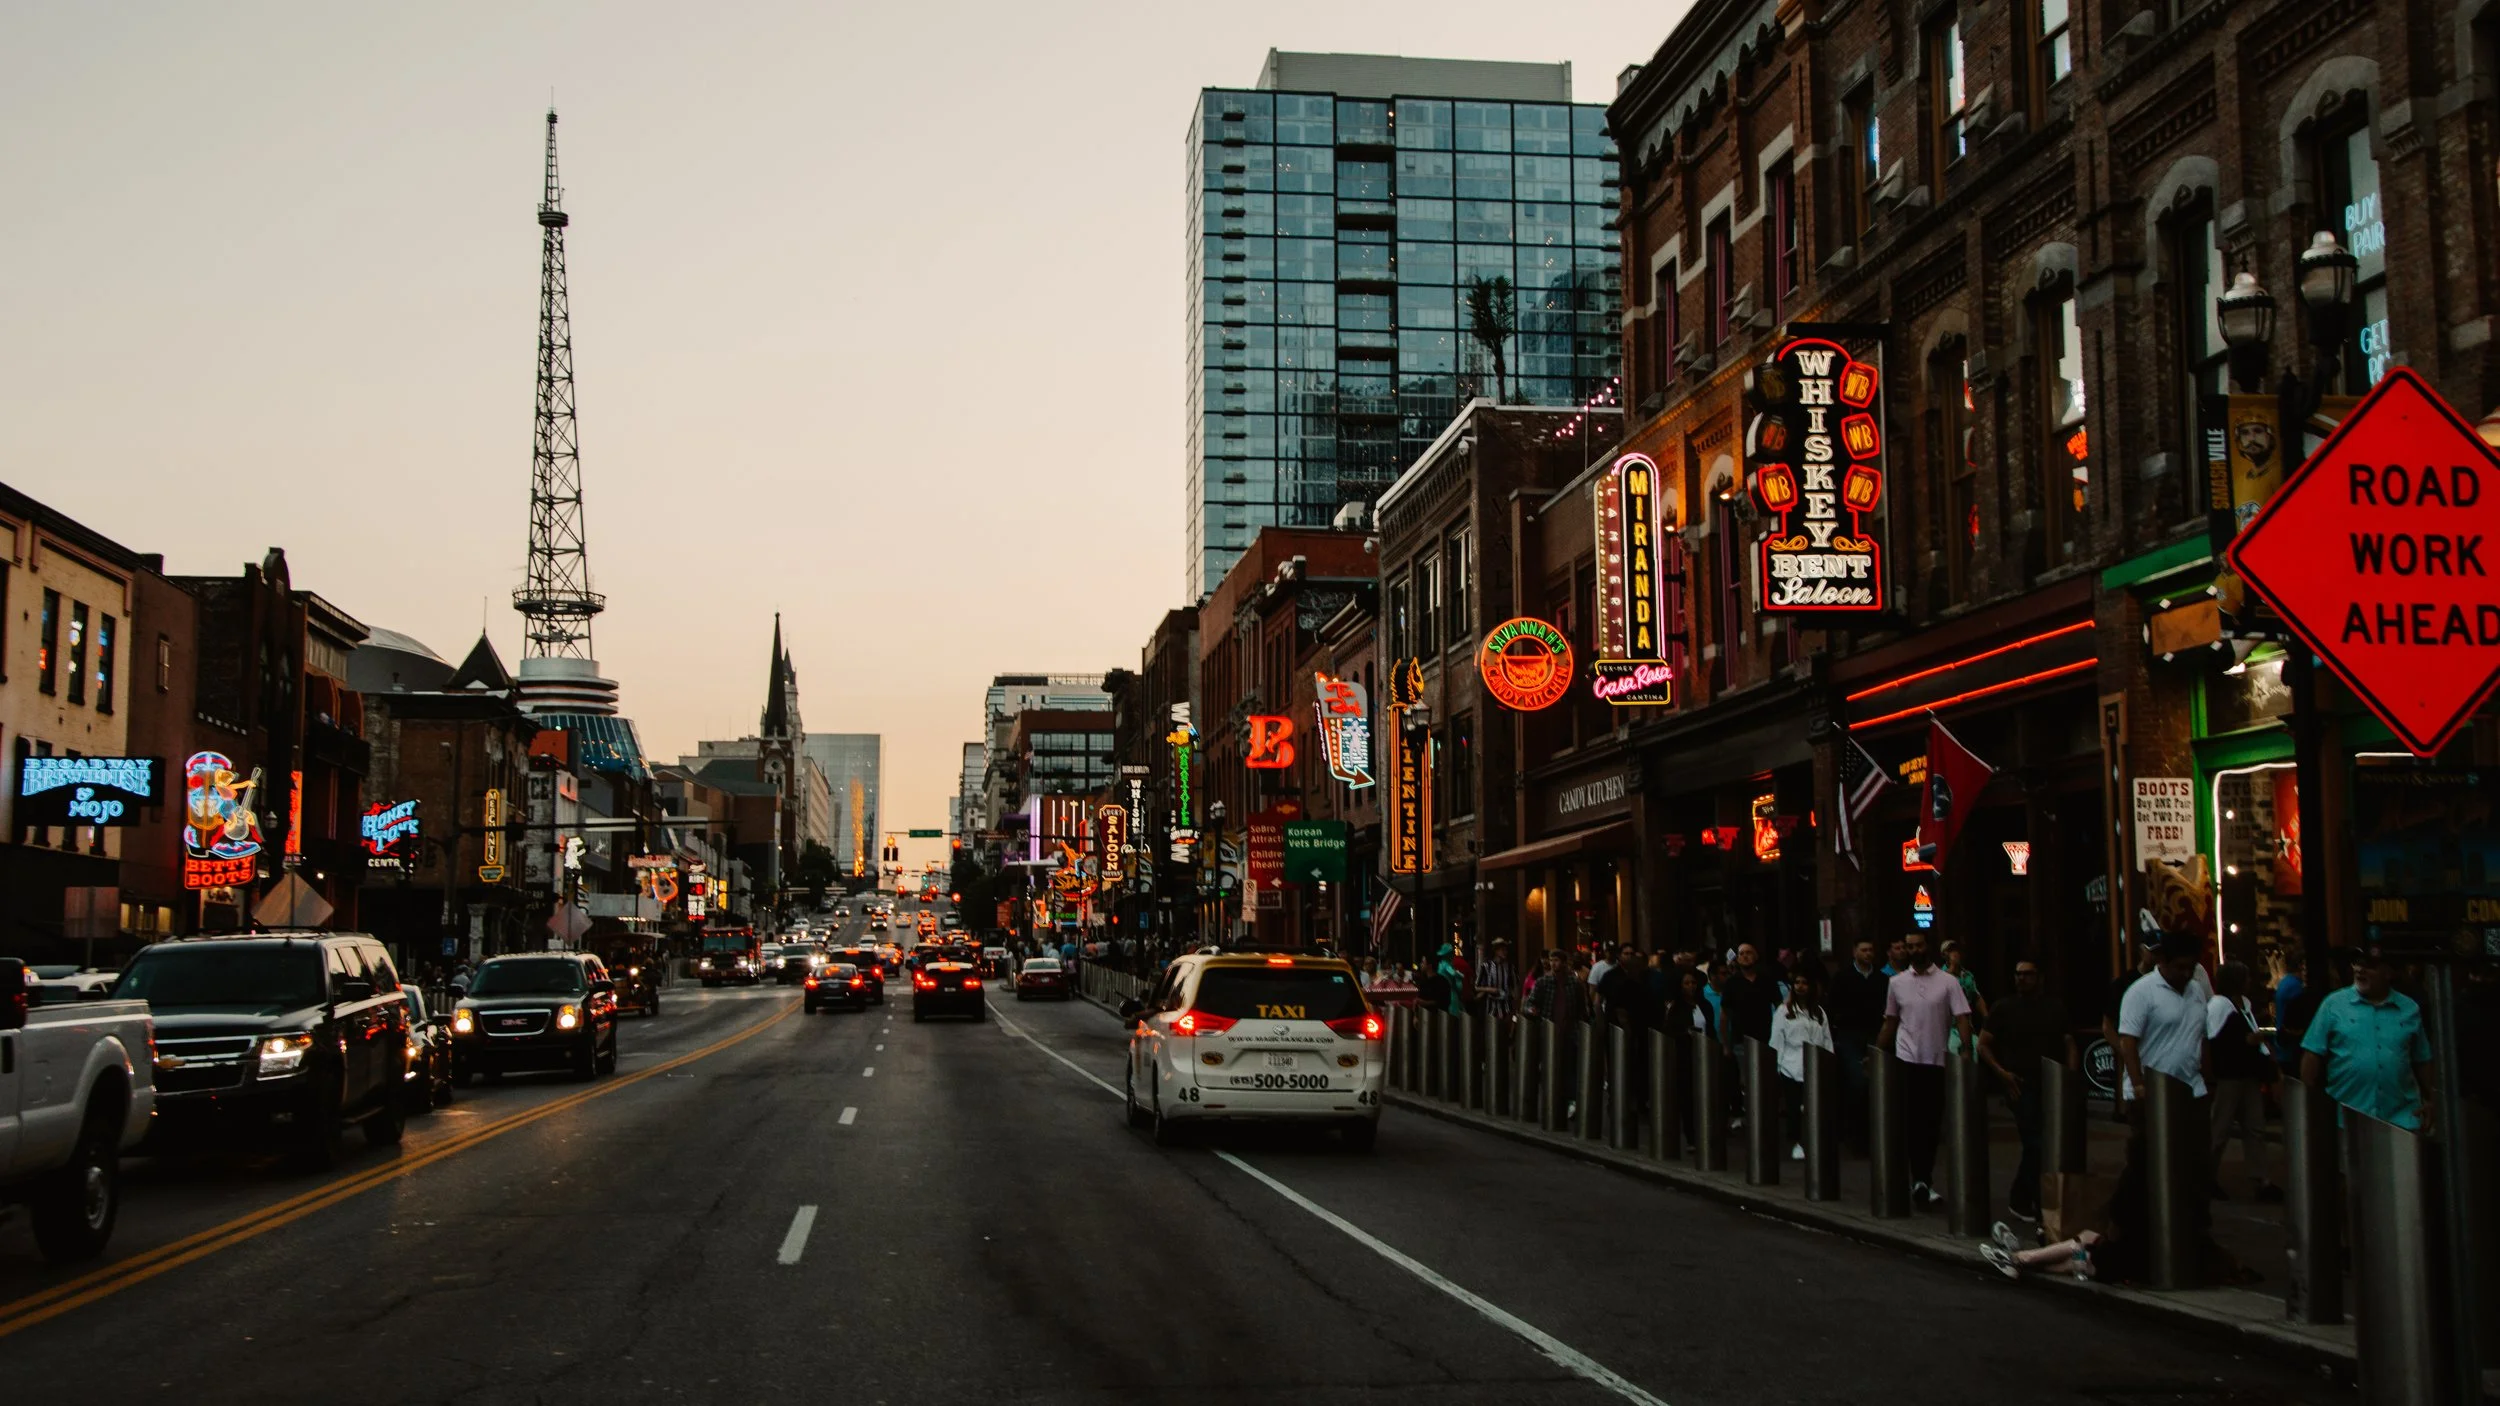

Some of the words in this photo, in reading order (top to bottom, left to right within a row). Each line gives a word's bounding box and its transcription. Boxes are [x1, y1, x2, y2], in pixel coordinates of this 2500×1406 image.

[2345, 193, 2377, 231] BUY
[2354, 221, 2386, 259] PAIR
[2361, 320, 2388, 354] GET
[1844, 373, 1870, 400] WB
[1795, 351, 1838, 548] WHISKEY
[1849, 425, 1874, 451] WB
[2207, 428, 2230, 510] SMASHVILLE
[1765, 475, 1791, 503] WB
[1848, 476, 1874, 503] WB
[2349, 464, 2480, 507] ROAD
[1629, 470, 1650, 650] MIRANDA
[1771, 555, 1872, 578] BENT
[2350, 533, 2486, 576] WORK
[1771, 577, 1873, 605] Saloon
[1488, 620, 1566, 654] SAVANNAH'S
[2341, 602, 2500, 646] AHEAD
[1486, 666, 1522, 705] CANDY
[1524, 666, 1569, 706] KITCHEN
[1593, 675, 1638, 698] Casa
[1634, 664, 1673, 688] Rosa
[24, 758, 153, 769] BROADWAY
[22, 769, 150, 797] BREWHOUSE
[76, 787, 94, 800] &
[1559, 785, 1586, 815] CANDY
[1587, 774, 1625, 807] KITCHEN
[2137, 782, 2189, 795] BOOTS
[68, 800, 124, 824] MOJO
[2136, 798, 2151, 810] Buy
[2155, 798, 2171, 808] ONE
[2174, 798, 2191, 808] Pair
[2136, 812, 2150, 822] Get
[2153, 812, 2172, 822] TWO
[2175, 812, 2192, 822] Pair
[362, 800, 417, 838] HONKY
[1250, 825, 1276, 833] SoBro
[1288, 827, 1323, 836] Korean
[1106, 815, 1119, 870] SALOON
[1288, 839, 1310, 848] Vets
[1313, 839, 1346, 849] Bridge
[2147, 826, 2184, 840] FREE!
[187, 857, 251, 872] BETTY
[188, 869, 251, 886] BOOTS
[368, 859, 405, 870] CENTR
[2367, 898, 2409, 922] JOIN
[1256, 1005, 1306, 1018] TAXI
[1254, 1074, 1328, 1088] 500-5000
[1179, 1088, 1199, 1102] 48
[1358, 1091, 1378, 1105] 48
